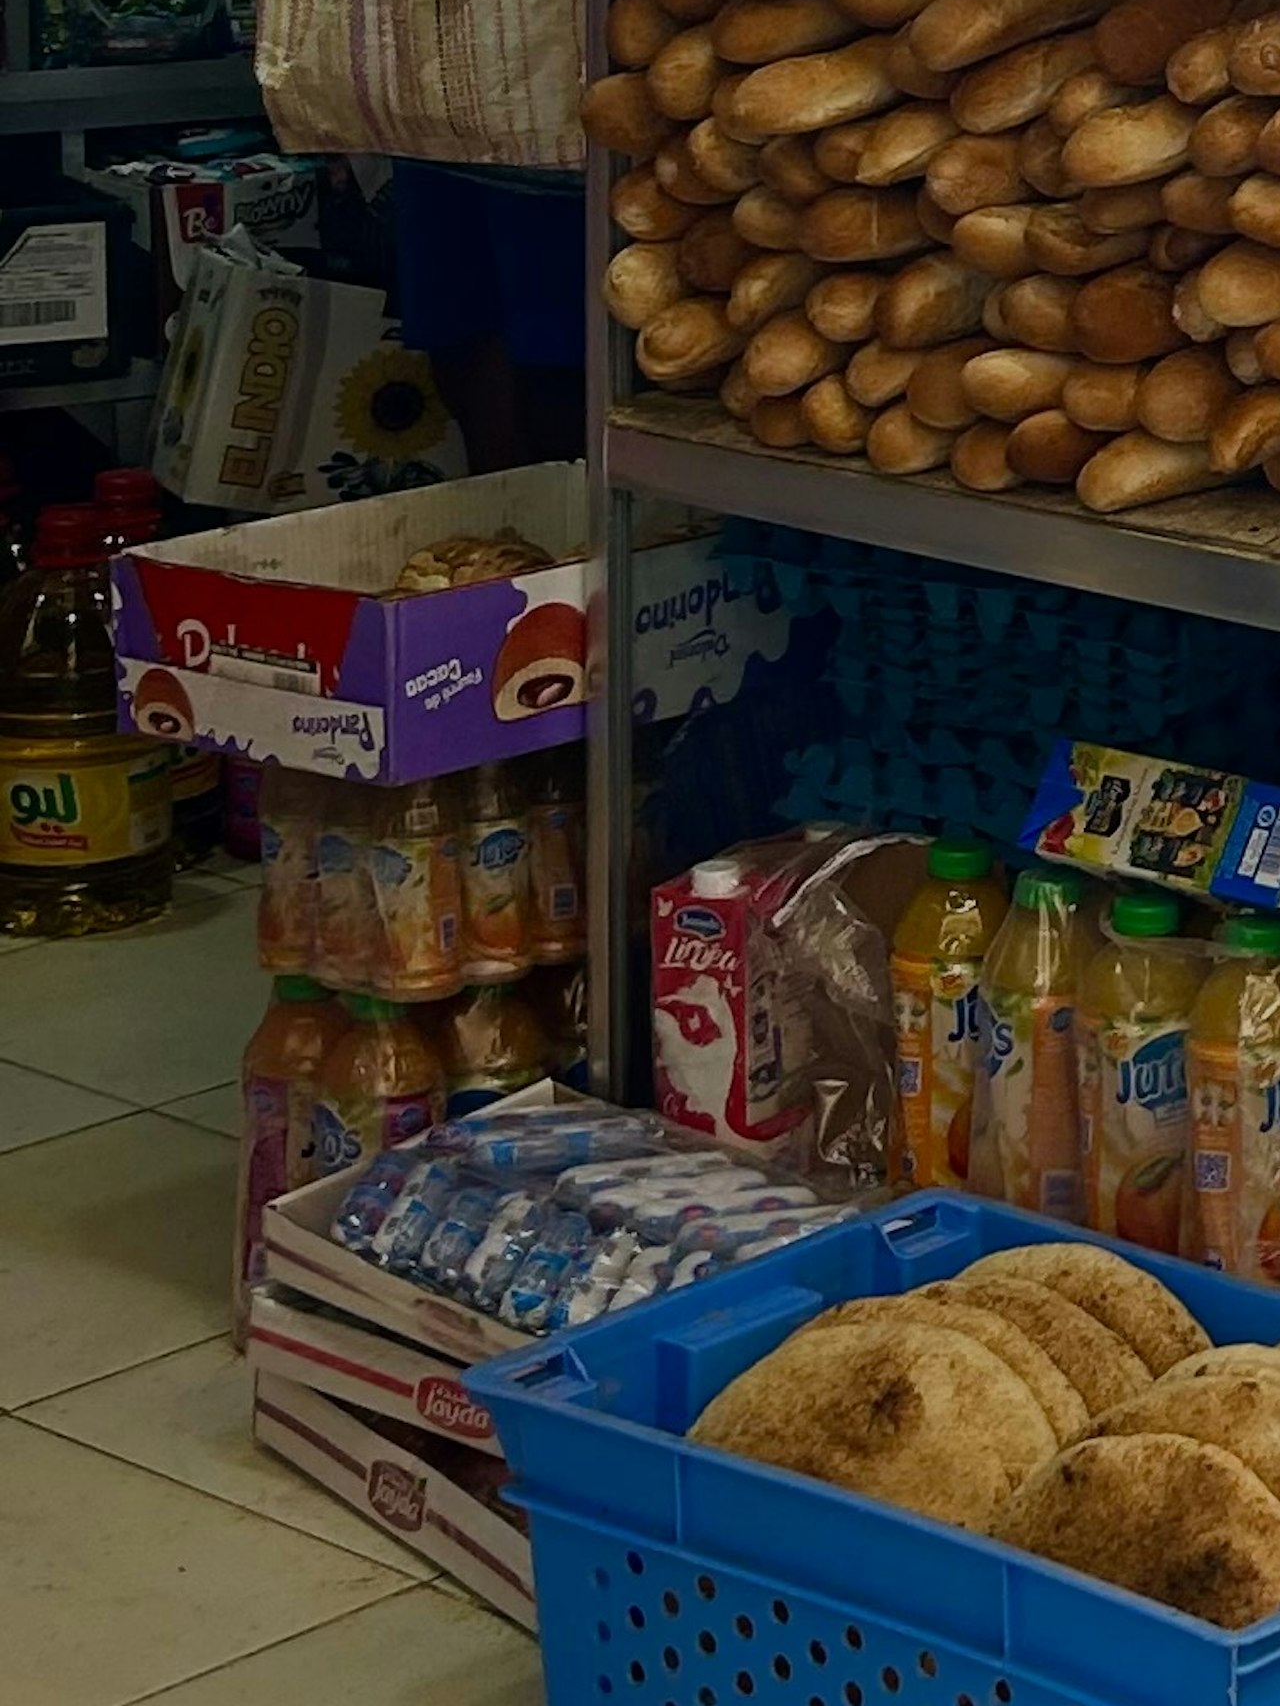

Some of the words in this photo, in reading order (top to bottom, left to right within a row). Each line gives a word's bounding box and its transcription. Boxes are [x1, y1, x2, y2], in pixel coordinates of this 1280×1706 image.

[230, 306, 300, 435] INDIO
[218, 436, 273, 490] EL
[404, 657, 462, 699] Cacao
